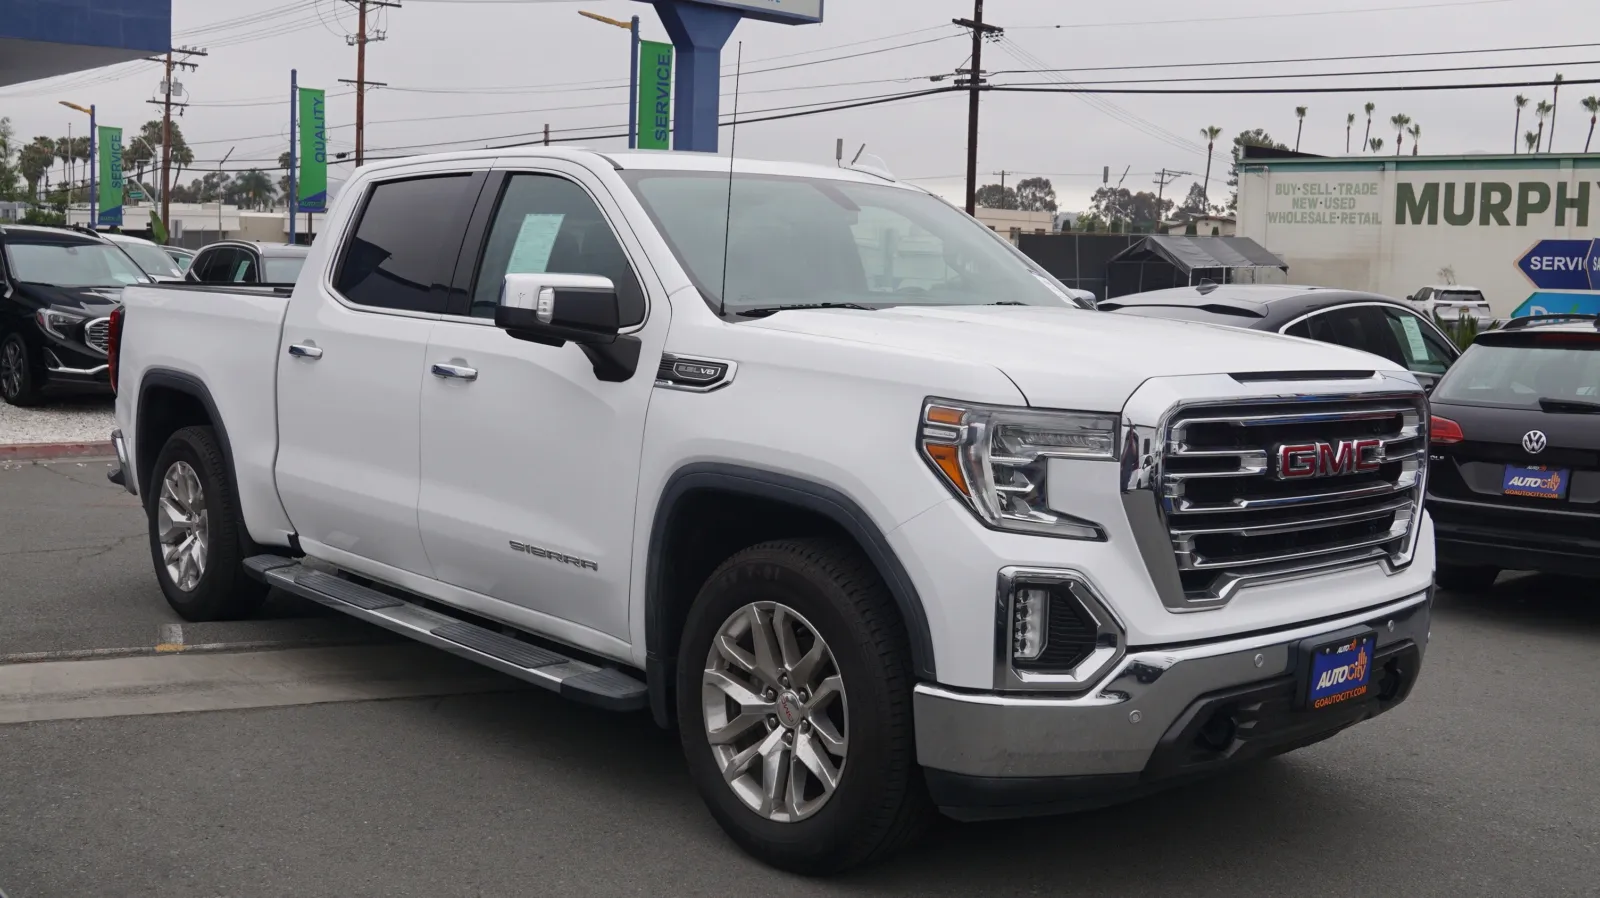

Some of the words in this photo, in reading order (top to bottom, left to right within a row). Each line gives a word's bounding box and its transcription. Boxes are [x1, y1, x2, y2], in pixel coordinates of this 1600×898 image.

[655, 49, 671, 142] SERVICE.
[1395, 181, 1600, 227] MURPH
[1278, 439, 1381, 480] GMC
[509, 540, 598, 571] SIERRA
